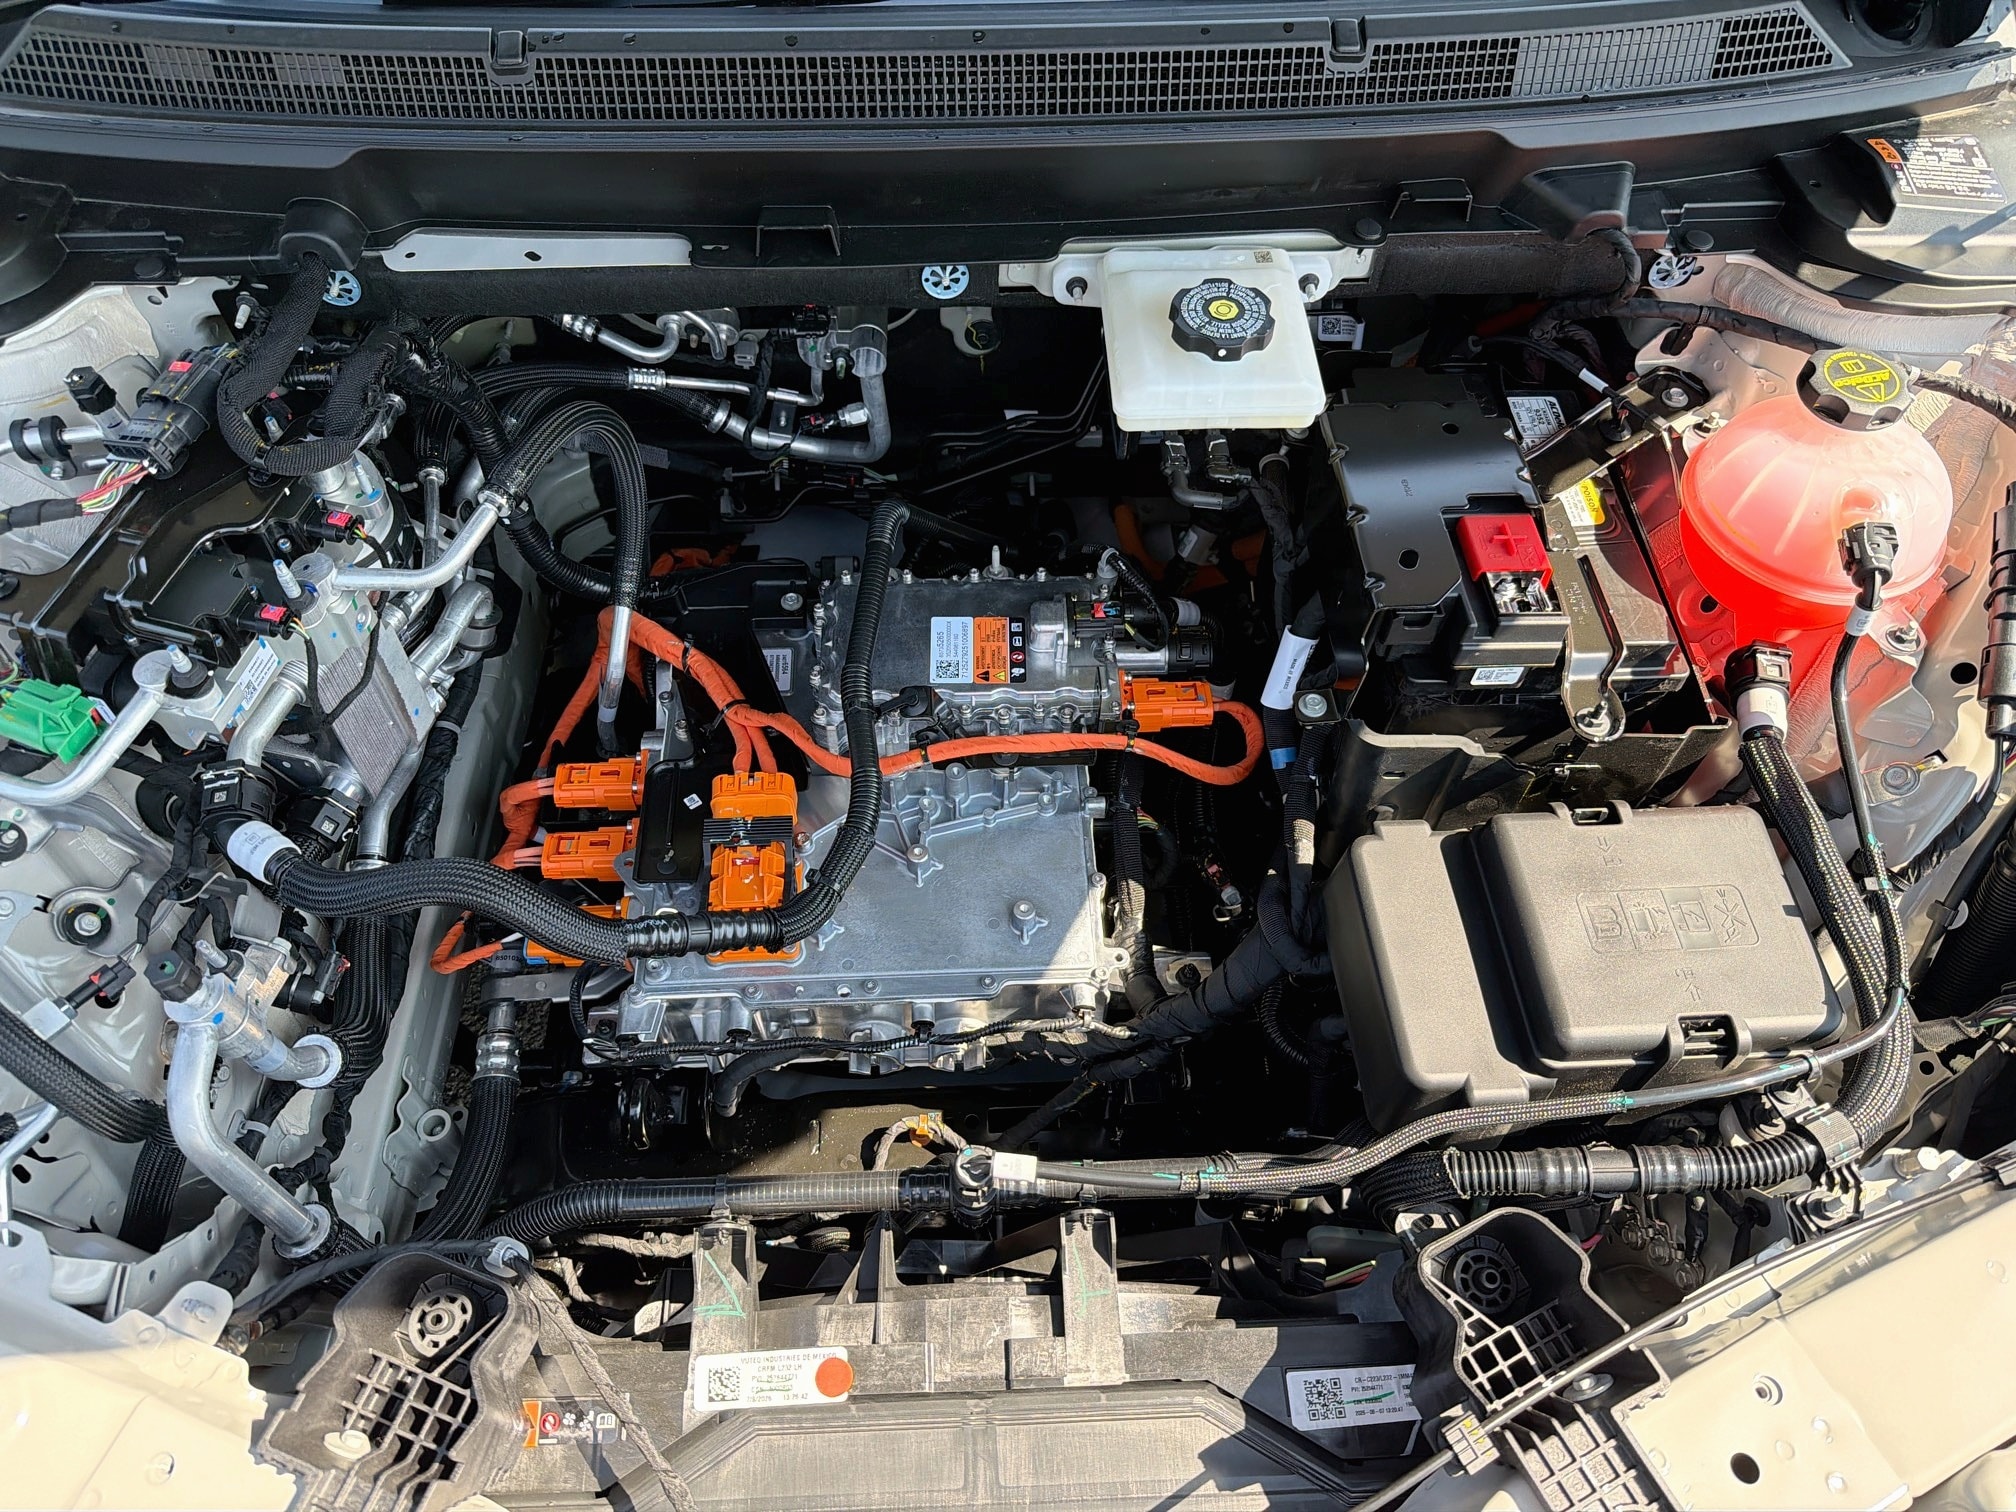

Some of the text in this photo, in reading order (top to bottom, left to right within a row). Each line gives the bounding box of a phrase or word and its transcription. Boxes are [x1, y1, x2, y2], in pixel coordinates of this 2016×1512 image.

[1834, 371, 1890, 388] ACDelco
[1534, 408, 1545, 425] 9352
[1547, 400, 1565, 430] ACDelc
[1581, 485, 1598, 512] POISON
[740, 1357, 761, 1365] VUTEQ
[763, 1354, 801, 1363] INDUSTRIES
[802, 1353, 810, 1361] DE
